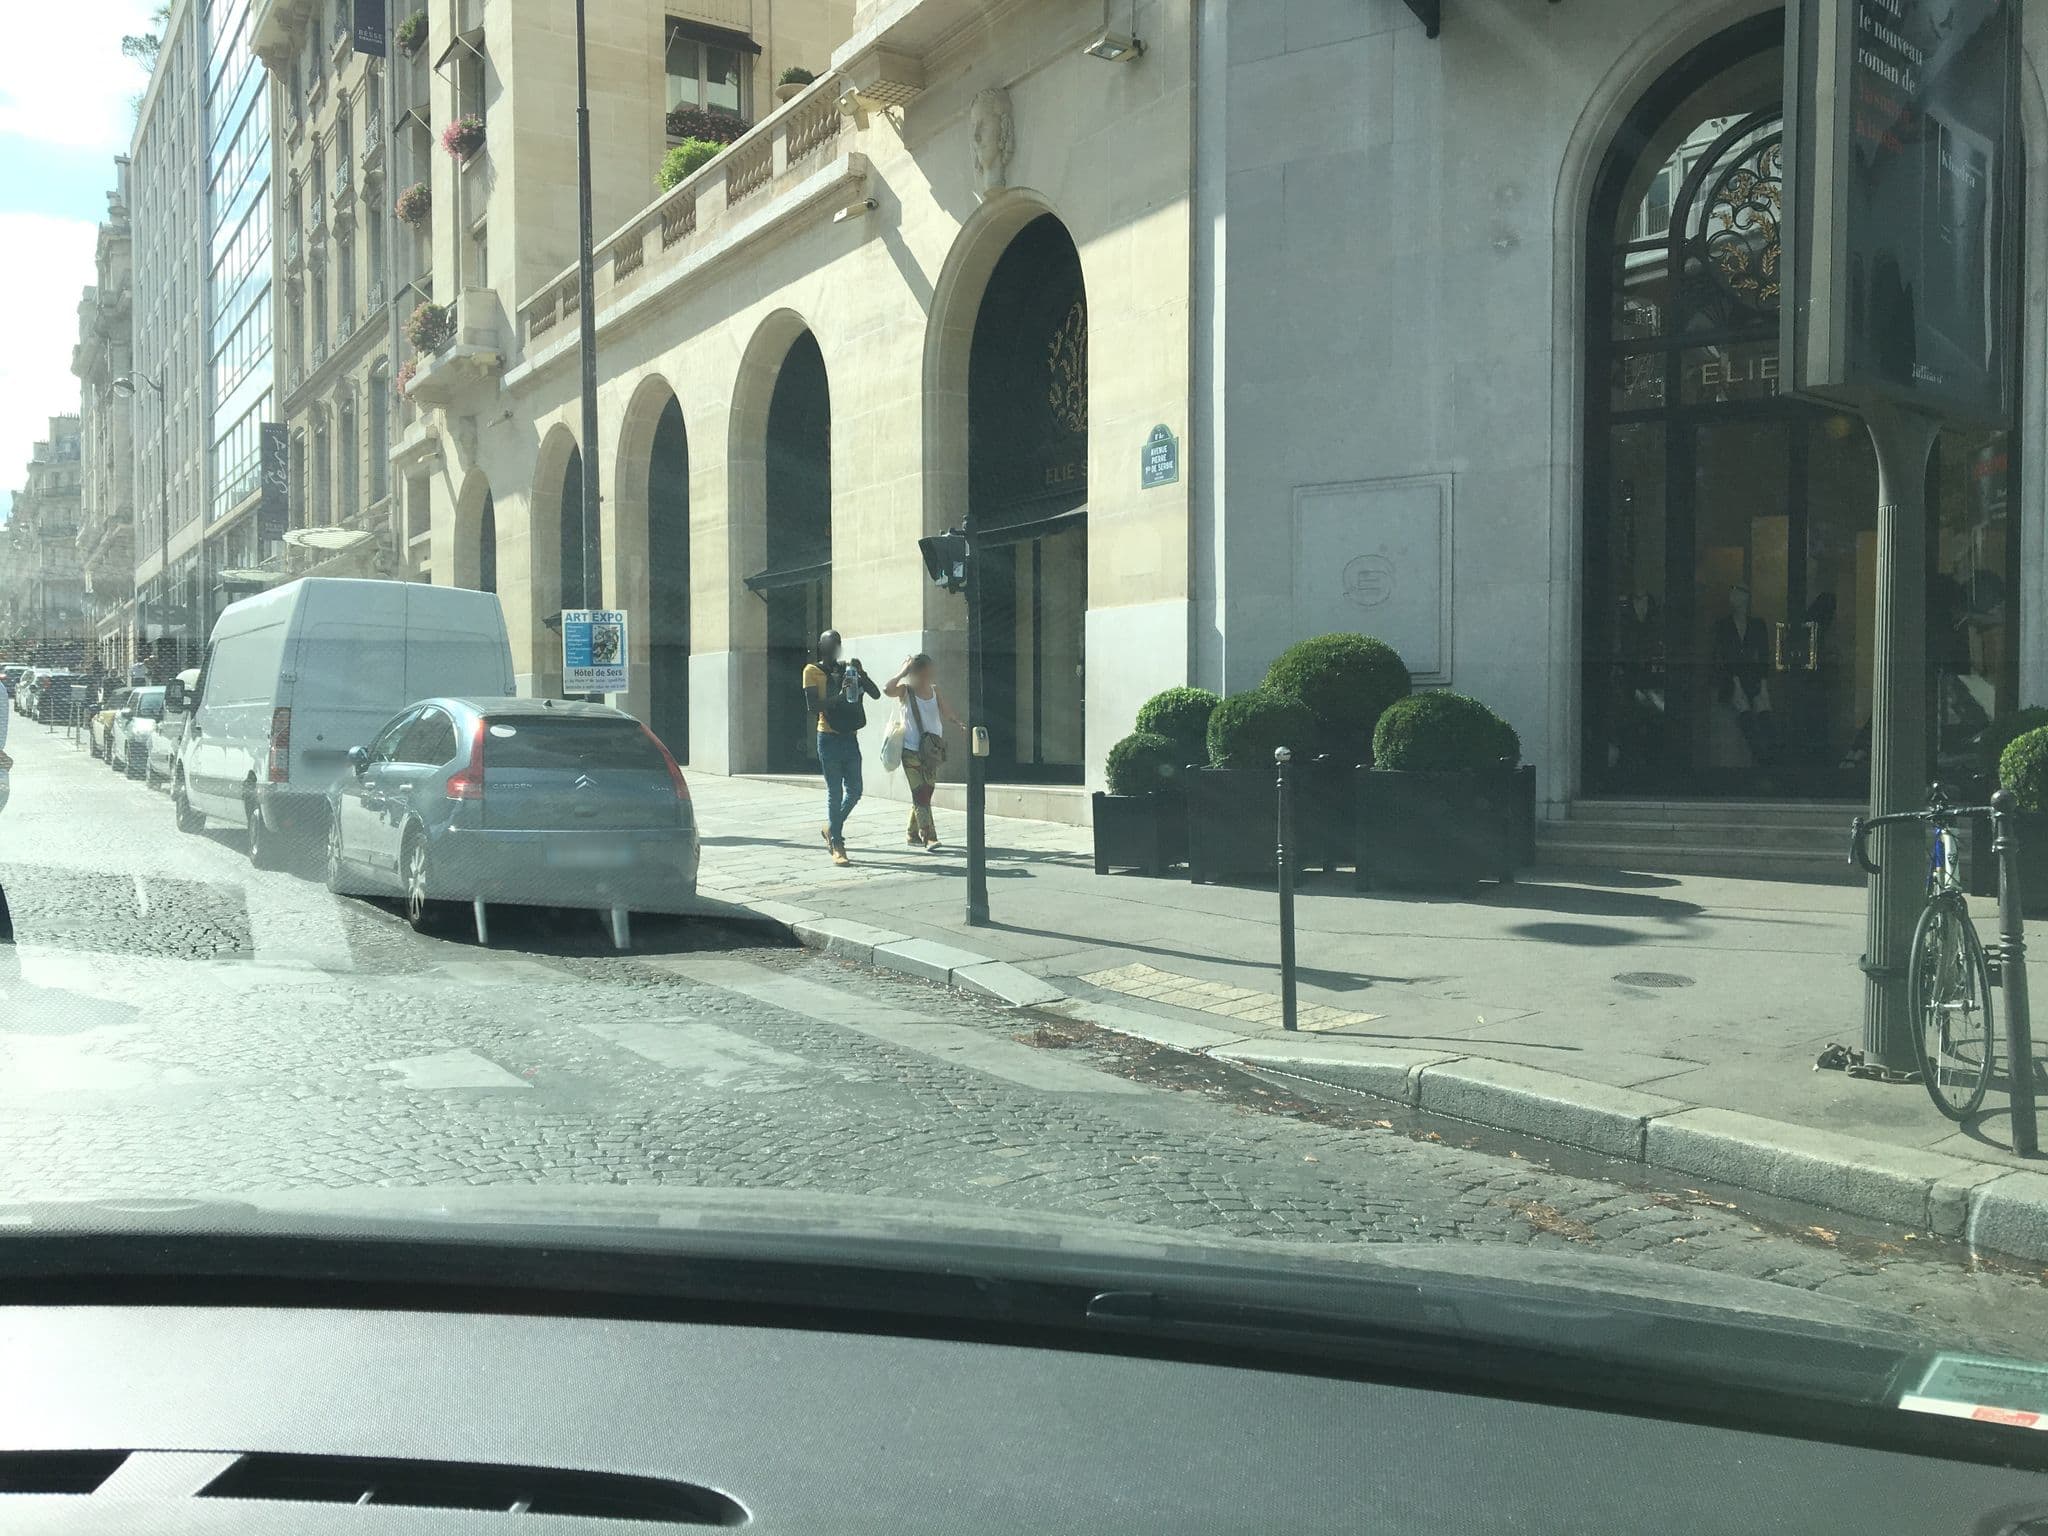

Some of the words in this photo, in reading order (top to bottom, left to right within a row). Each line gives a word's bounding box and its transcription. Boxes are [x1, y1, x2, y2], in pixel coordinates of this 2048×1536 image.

[1859, 4, 1872, 32] le
[1874, 21, 1923, 67] nouveau
[1858, 48, 1899, 85] roman
[1902, 68, 1916, 96] de
[1702, 356, 1780, 385] ELIE
[565, 612, 588, 622] ART
[592, 612, 624, 622] EXPO
[595, 669, 605, 677] de
[606, 668, 623, 677] Sers
